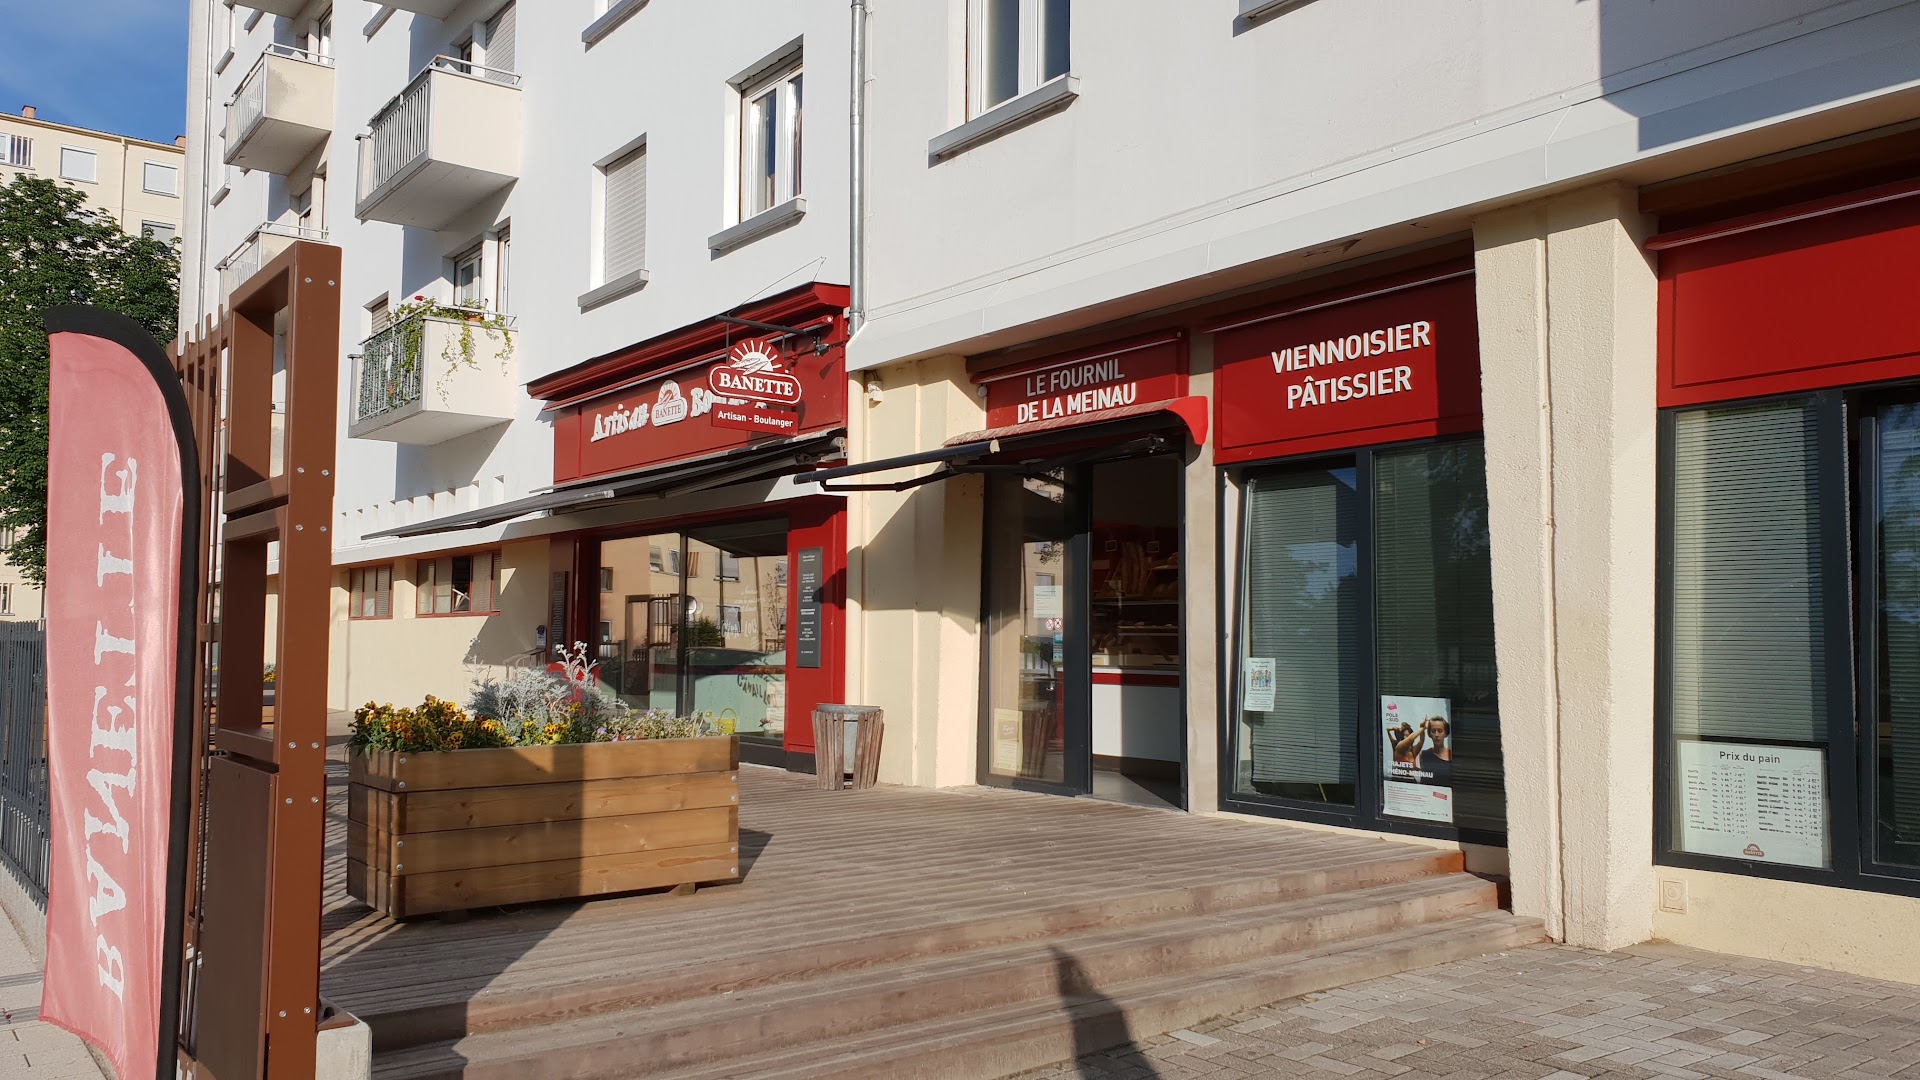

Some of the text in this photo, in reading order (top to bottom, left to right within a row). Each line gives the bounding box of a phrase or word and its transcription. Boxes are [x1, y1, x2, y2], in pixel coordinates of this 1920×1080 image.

[1271, 320, 1431, 375] VIENNOISIER
[718, 371, 794, 397] BANETTE
[1026, 358, 1126, 398] LE FOURNIL
[1286, 365, 1413, 411] PÂTISSIER
[591, 403, 650, 443] Artisan
[655, 404, 682, 419] BANETTE
[717, 410, 747, 423] Artisan
[753, 414, 793, 429] Boulanger
[1017, 382, 1137, 424] DE LA MEINAU
[1719, 750, 1781, 765] Prix du pain
